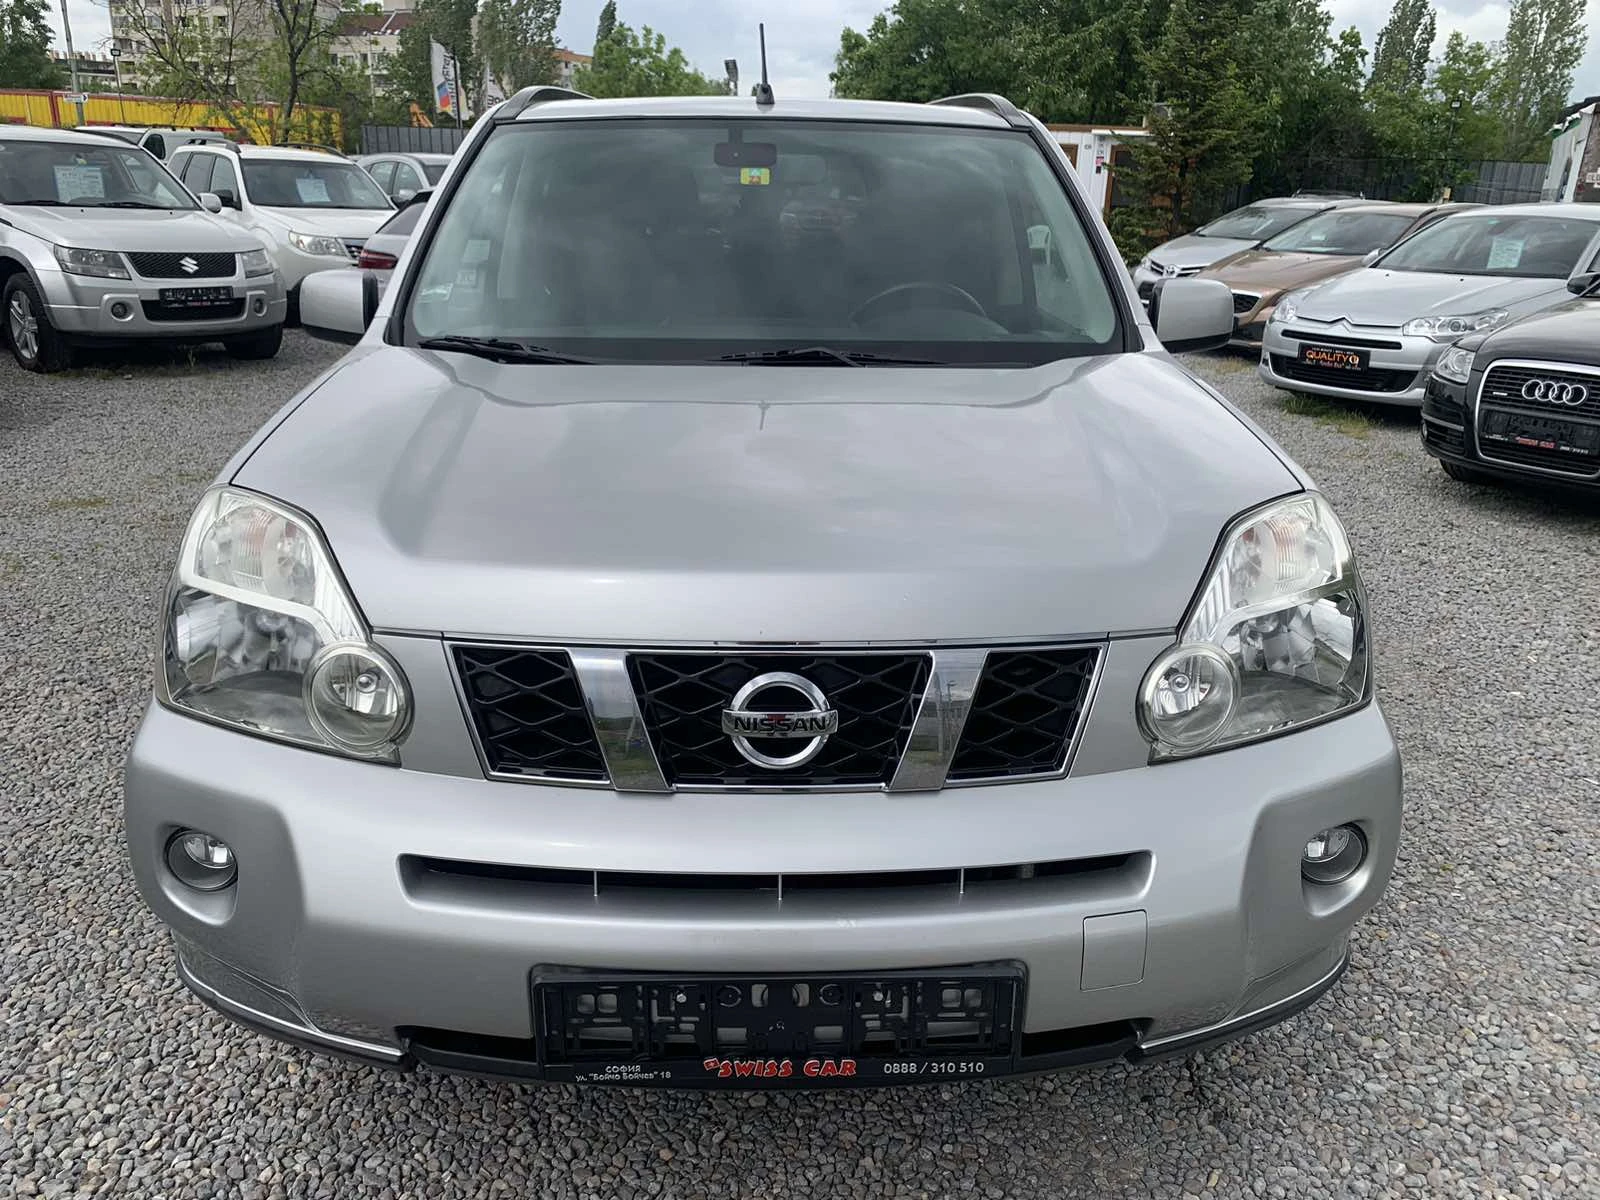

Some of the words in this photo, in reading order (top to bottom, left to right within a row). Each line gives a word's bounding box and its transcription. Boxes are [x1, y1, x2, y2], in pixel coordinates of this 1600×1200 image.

[1305, 350, 1349, 362] QUALITY
[734, 716, 826, 733] NISSAN
[605, 1065, 641, 1073] СОФИЯ
[718, 1060, 793, 1077] SWISS
[803, 1060, 857, 1077] CAR
[883, 1063, 918, 1074] 0888
[931, 1063, 956, 1073] 310
[960, 1063, 985, 1073] 510
[660, 1071, 672, 1079] 18
